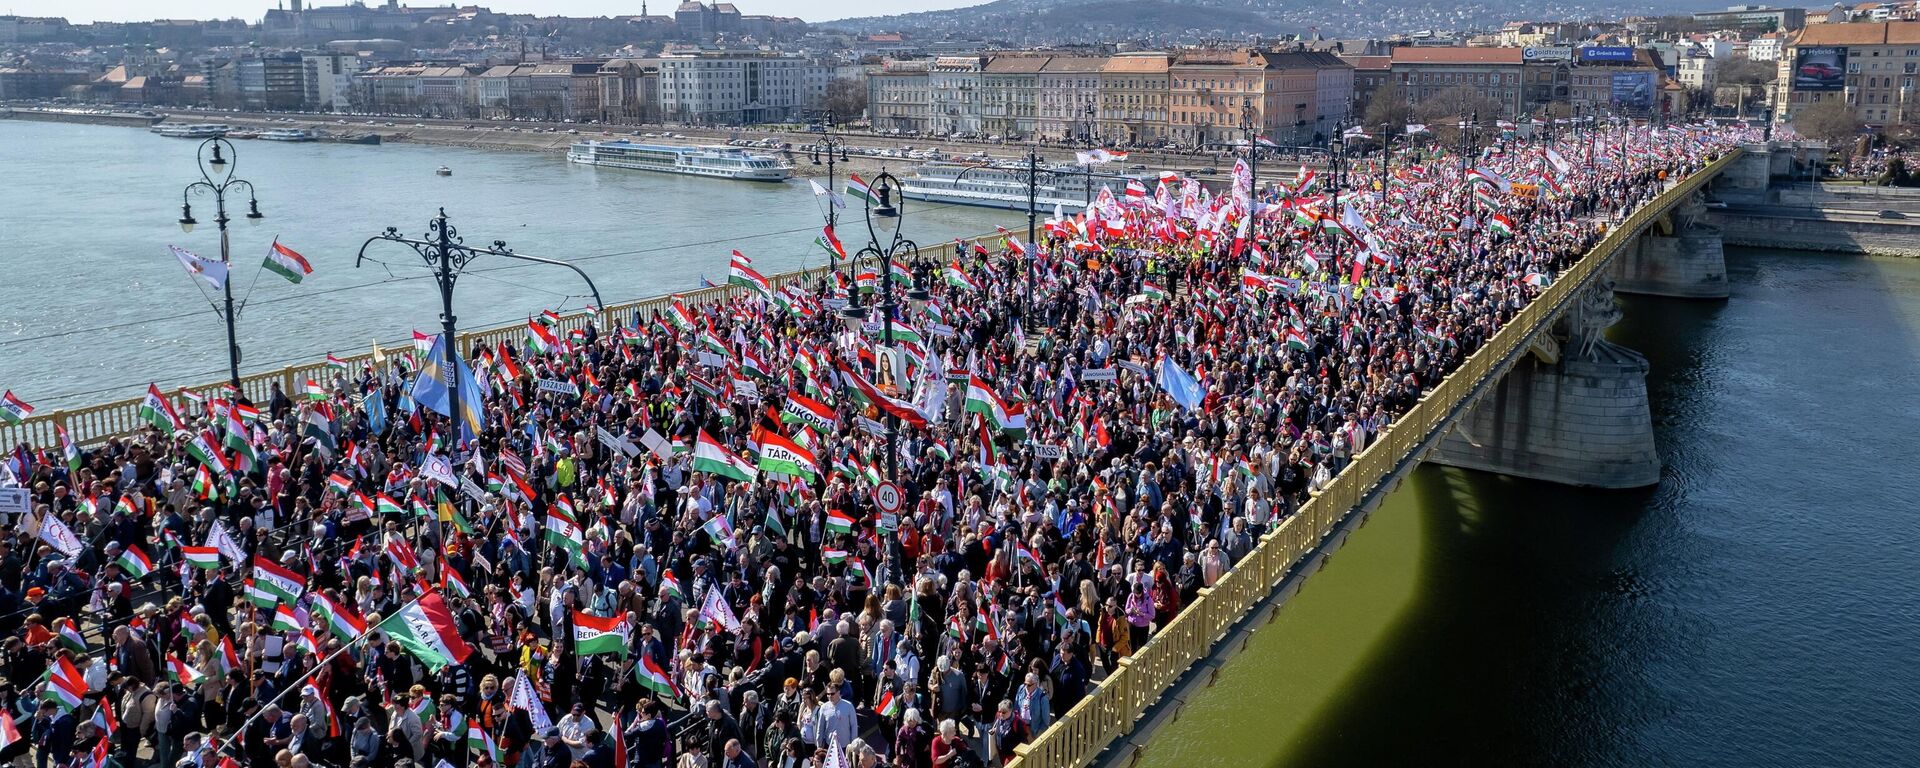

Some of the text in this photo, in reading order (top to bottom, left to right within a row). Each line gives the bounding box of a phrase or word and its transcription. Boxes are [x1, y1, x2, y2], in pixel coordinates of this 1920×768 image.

[1533, 48, 1571, 56] goldtresor
[203, 444, 216, 464] TATA
[1036, 446, 1057, 456] TASS
[882, 490, 894, 504] 40
